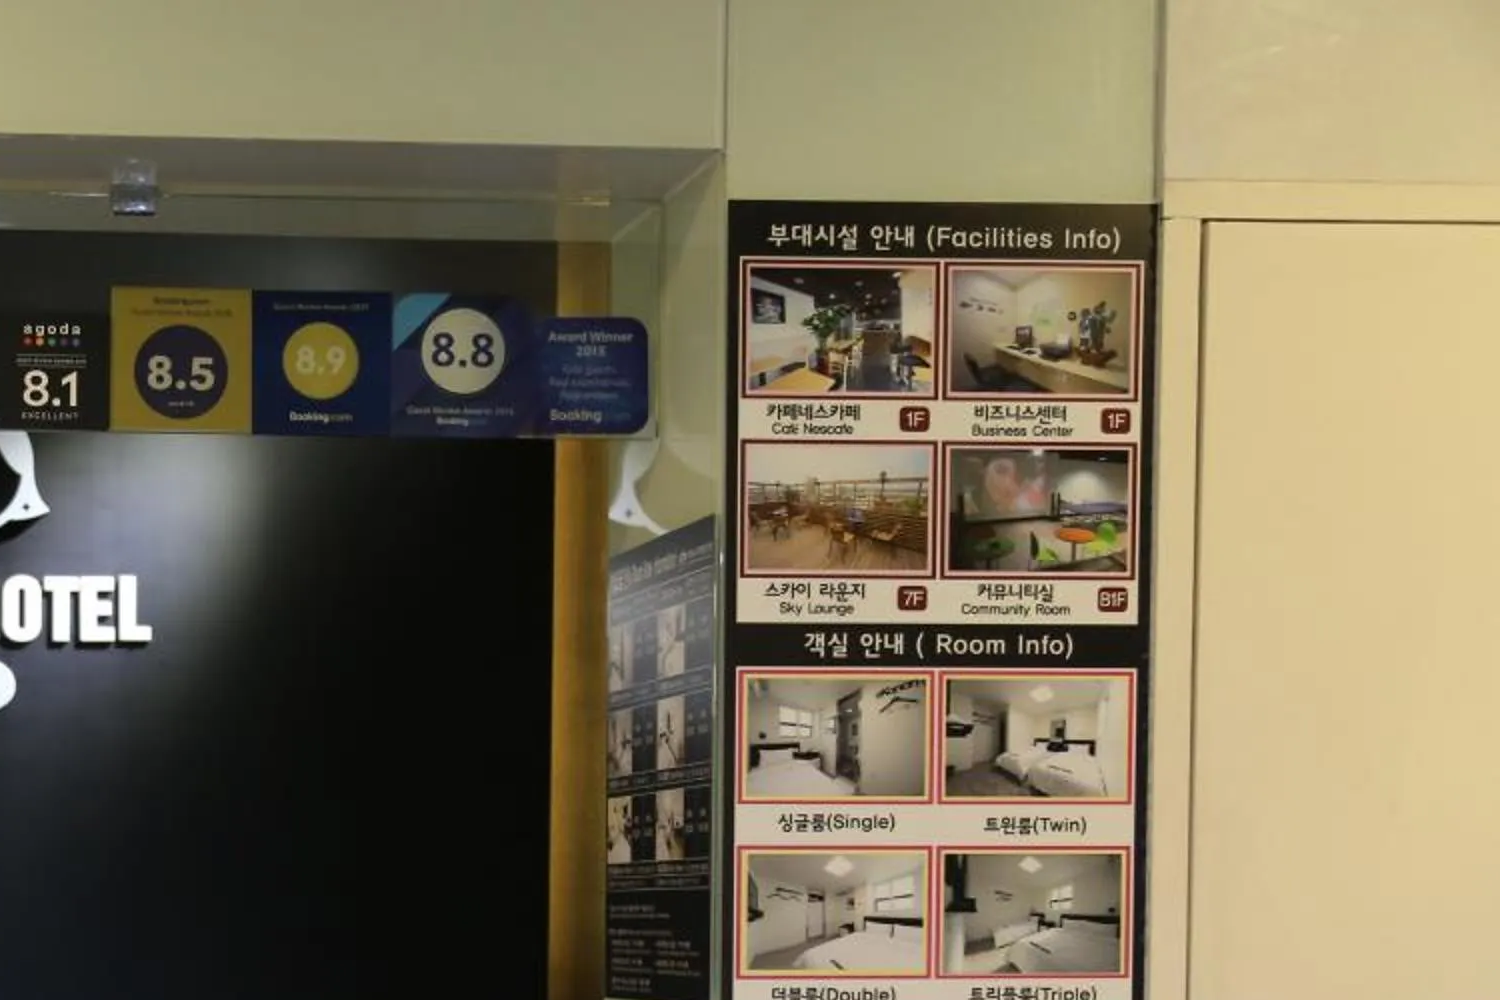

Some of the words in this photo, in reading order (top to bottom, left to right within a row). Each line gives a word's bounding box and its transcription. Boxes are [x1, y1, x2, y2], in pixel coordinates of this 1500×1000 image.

[767, 225, 858, 250] 부대시설
[870, 224, 914, 250] 안내
[926, 226, 1053, 252] (Facilities
[1065, 227, 1121, 253] Info)
[23, 323, 82, 336] agoda
[431, 333, 494, 367] 8.8
[296, 345, 347, 375] 8.9
[147, 355, 215, 391] 8.5
[23, 369, 77, 407] 8.1
[766, 404, 861, 422] 카페네스카페
[905, 411, 925, 427] 1F
[974, 406, 1067, 424] 비즈니스센터
[1108, 414, 1127, 429] 1F
[972, 424, 1028, 437] Business
[1032, 424, 1074, 437] Center
[765, 583, 811, 598] 스카이
[819, 583, 866, 601] 라운지
[903, 592, 924, 606] 7F
[977, 584, 1054, 601] 커뮤니티실
[779, 602, 802, 617] Sky
[808, 602, 854, 617] Lounge
[961, 603, 1029, 618] Community
[1036, 603, 1071, 616] Room
[804, 632, 849, 657] 객실
[860, 632, 904, 657] 안내
[937, 634, 1006, 654] Room
[1019, 633, 1074, 659] Info)
[778, 813, 896, 833] 싱글룸(Single)
[984, 816, 1088, 835] 트윈룸(Twin)
